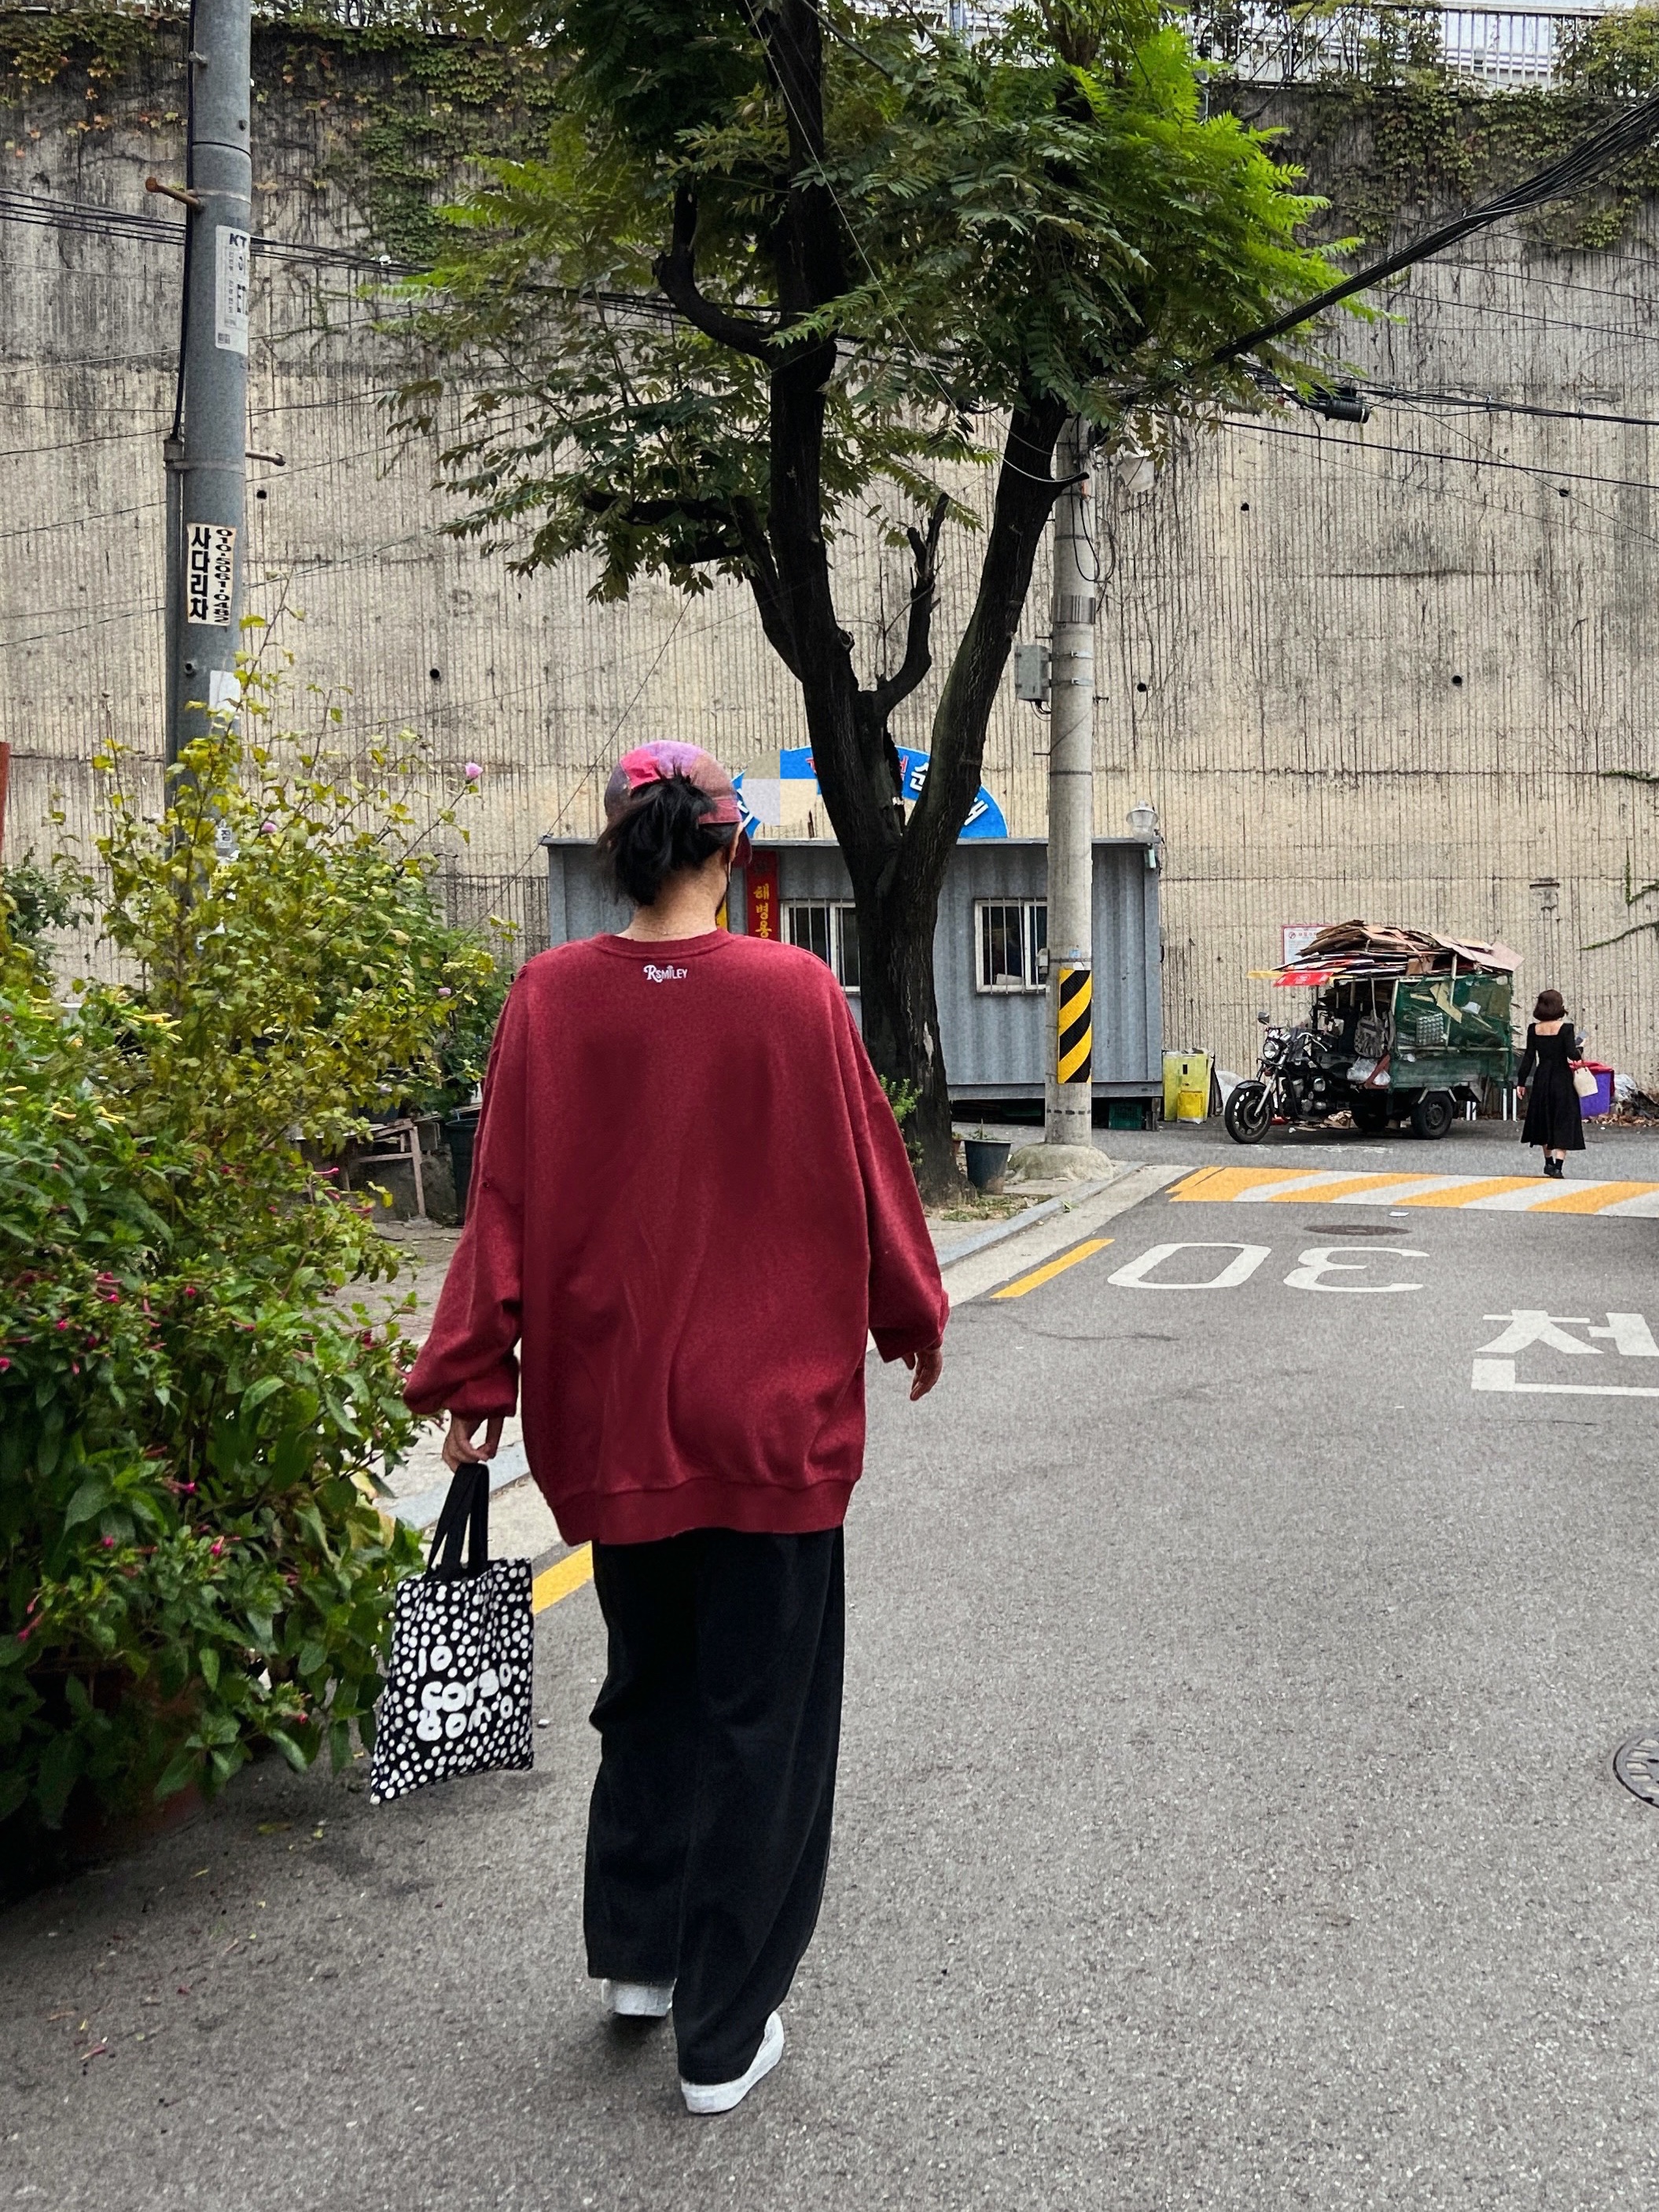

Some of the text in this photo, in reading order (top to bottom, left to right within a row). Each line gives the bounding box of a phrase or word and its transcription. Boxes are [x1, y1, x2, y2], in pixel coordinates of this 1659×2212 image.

[229, 233, 248, 248] KT
[190, 527, 211, 620] 사다리차
[1108, 1242, 1430, 1293] 30
[1471, 1309, 1659, 1397] 천
